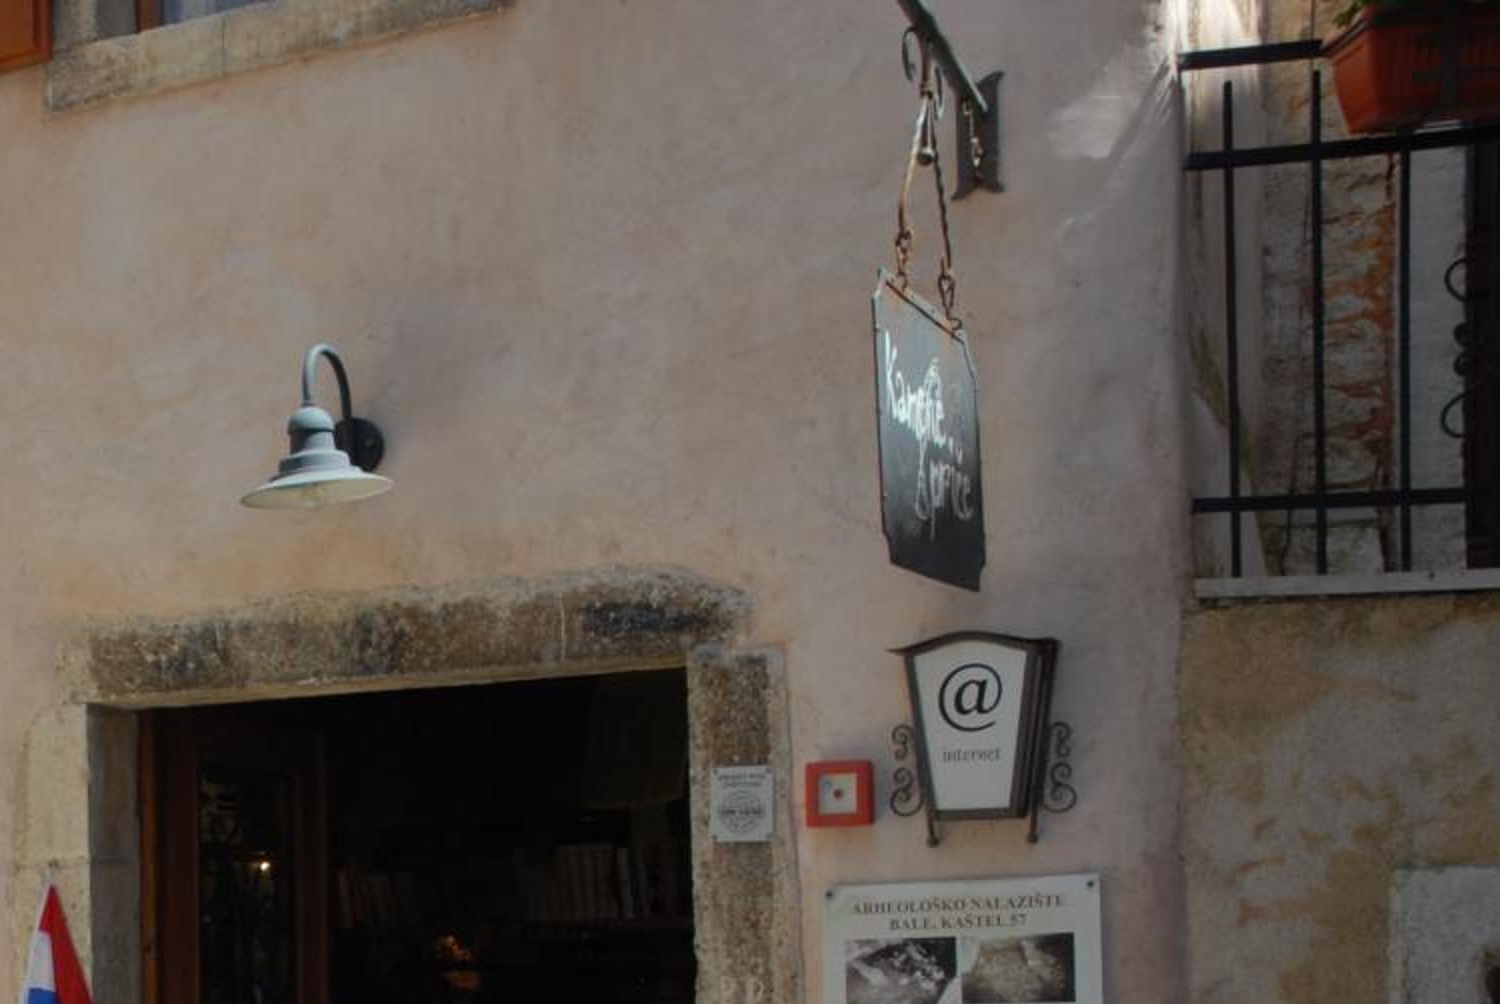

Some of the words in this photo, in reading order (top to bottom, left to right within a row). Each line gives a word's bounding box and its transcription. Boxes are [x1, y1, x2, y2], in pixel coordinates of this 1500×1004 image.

[937, 662, 1003, 732] @
[940, 746, 1002, 762] internet
[852, 895, 966, 915] ARHEOLOŠKO
[970, 891, 1063, 911] NALAZIŠTE
